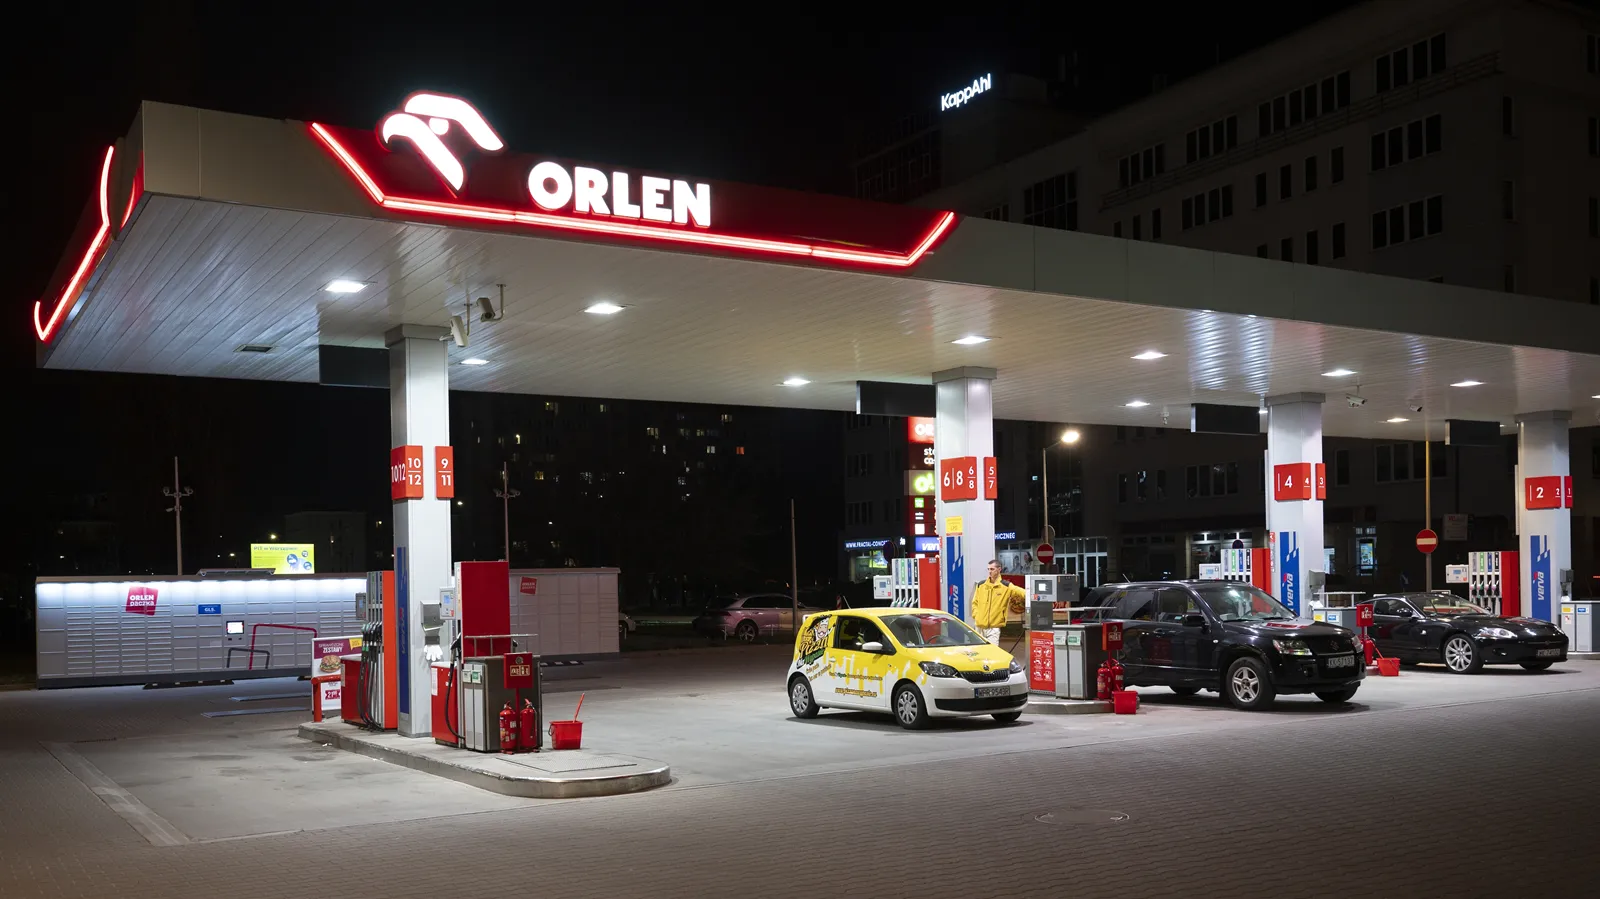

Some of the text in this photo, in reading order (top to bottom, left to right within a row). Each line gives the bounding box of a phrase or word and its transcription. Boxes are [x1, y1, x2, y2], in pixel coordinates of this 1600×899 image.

[941, 73, 991, 111] KappAhl
[528, 161, 711, 227] ORLEN
[408, 458, 421, 468] 10
[441, 458, 448, 468] 9
[968, 466, 974, 475] 6
[989, 466, 994, 475] 5
[408, 474, 422, 485] 12
[441, 475, 451, 486] 11
[944, 470, 963, 487] 6 8
[1284, 475, 1293, 488] 4
[968, 480, 974, 488] 8
[989, 480, 994, 489] 7
[1536, 486, 1544, 498] 2
[1555, 487, 1560, 495] 2
